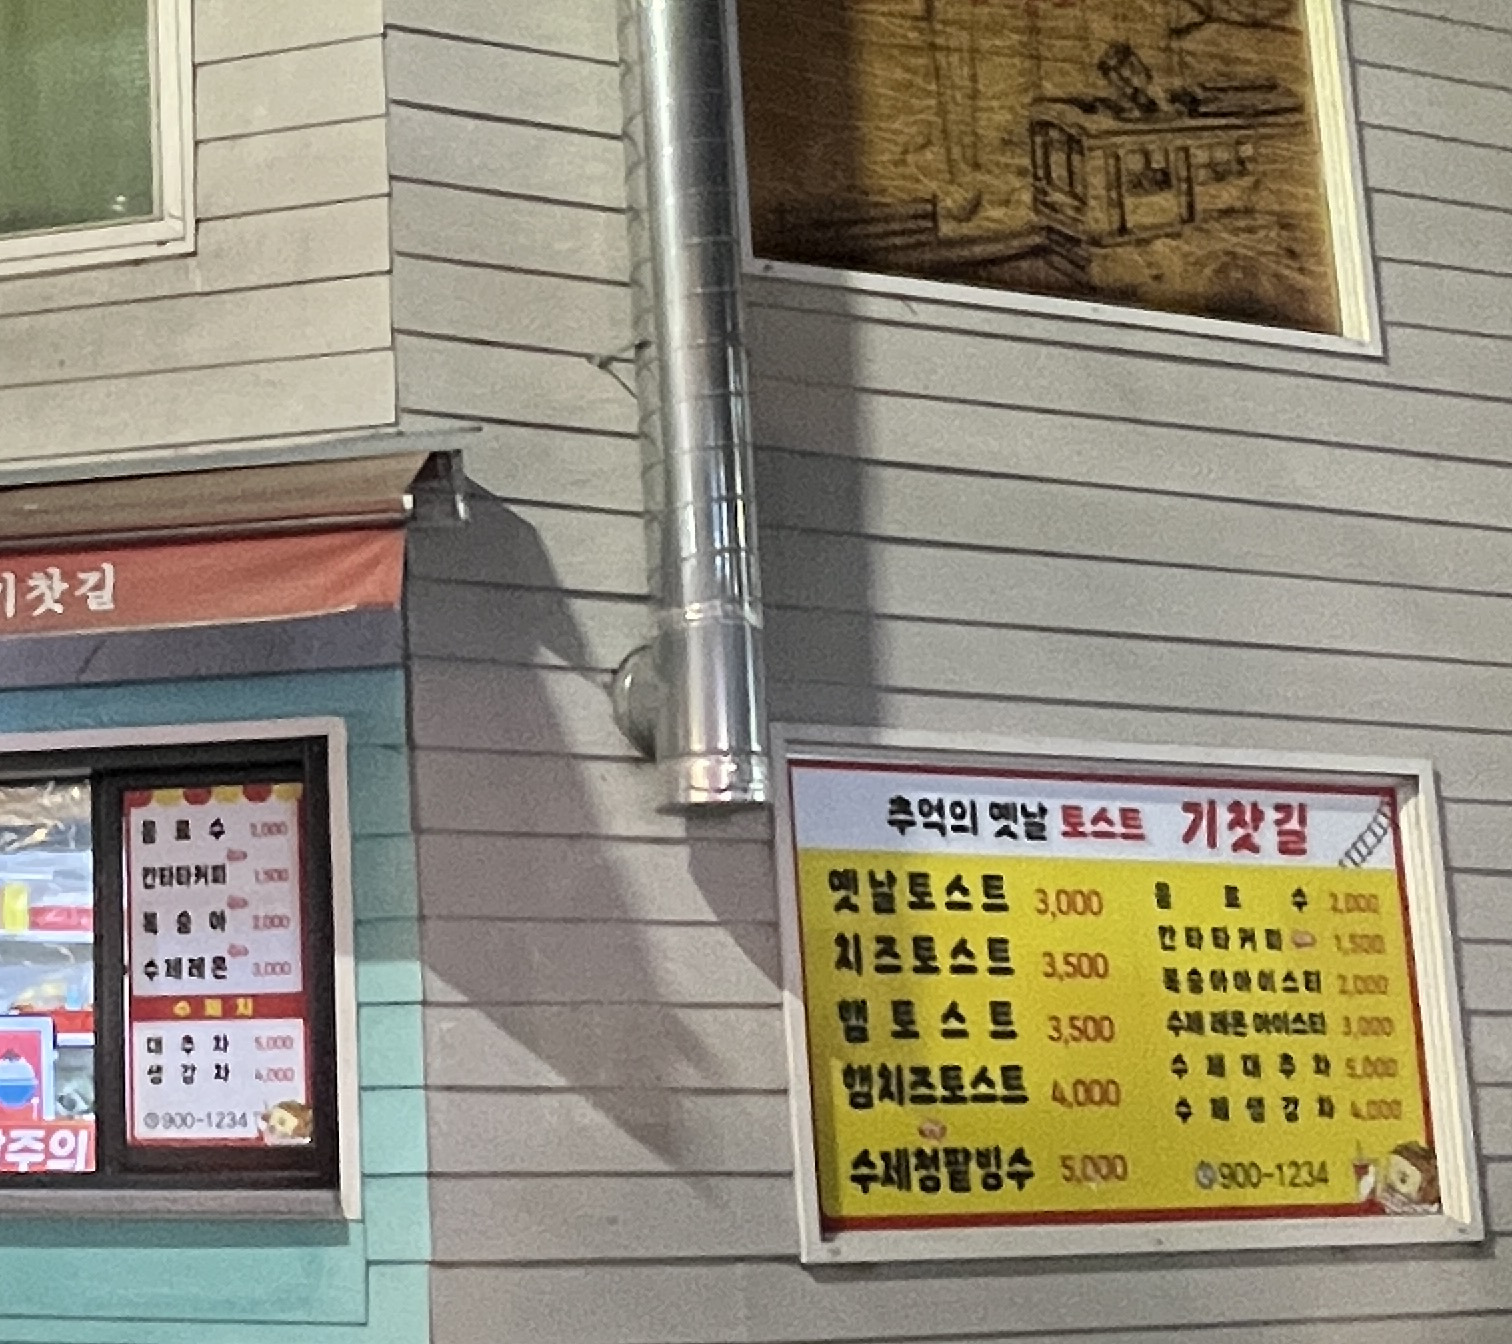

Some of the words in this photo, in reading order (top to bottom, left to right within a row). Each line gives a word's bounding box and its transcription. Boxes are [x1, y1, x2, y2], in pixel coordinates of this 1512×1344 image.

[888, 794, 978, 837] 추억의
[988, 801, 1049, 841] 옛날
[1061, 804, 1146, 841] 토스트
[1182, 799, 1308, 856] 기찻길
[828, 868, 1009, 915] 옛날토스트
[1034, 888, 1104, 921] 3,000
[834, 932, 1015, 977] 치즈토스트
[1043, 951, 1110, 982] 3,500
[1048, 1015, 1116, 1047] 3,500
[843, 1063, 1029, 1110] 햄치즈토스트
[1051, 1078, 1121, 1108] 4,000
[1060, 1154, 1128, 1184] 5,000
[1218, 1159, 1329, 1189] 900-1234
